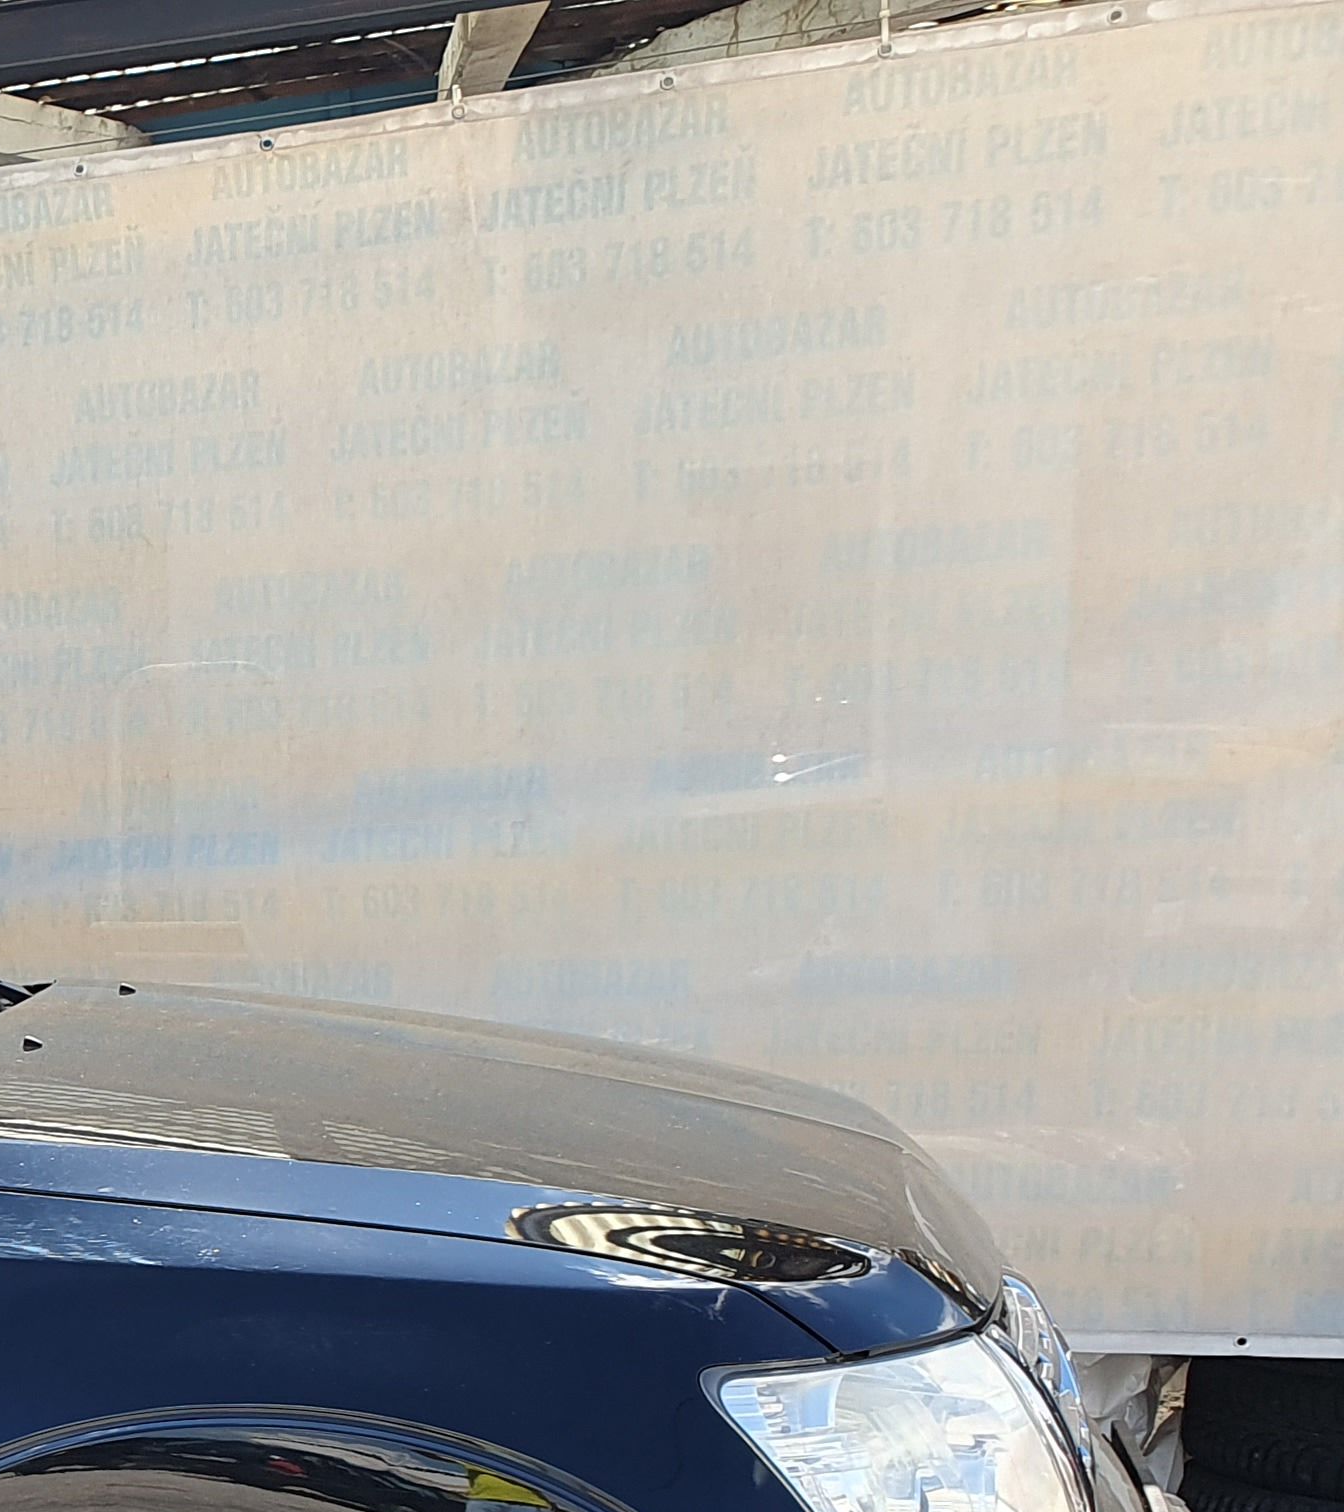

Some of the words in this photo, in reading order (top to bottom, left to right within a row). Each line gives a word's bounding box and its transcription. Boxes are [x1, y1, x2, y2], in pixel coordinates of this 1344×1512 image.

[844, 49, 1078, 117] AUTOBAZAR
[516, 99, 729, 163] AUTOBAZAR
[213, 140, 408, 202] AUTOBAZAR
[525, 246, 586, 294] 603
[607, 239, 670, 282] 718
[684, 229, 754, 273] 514
